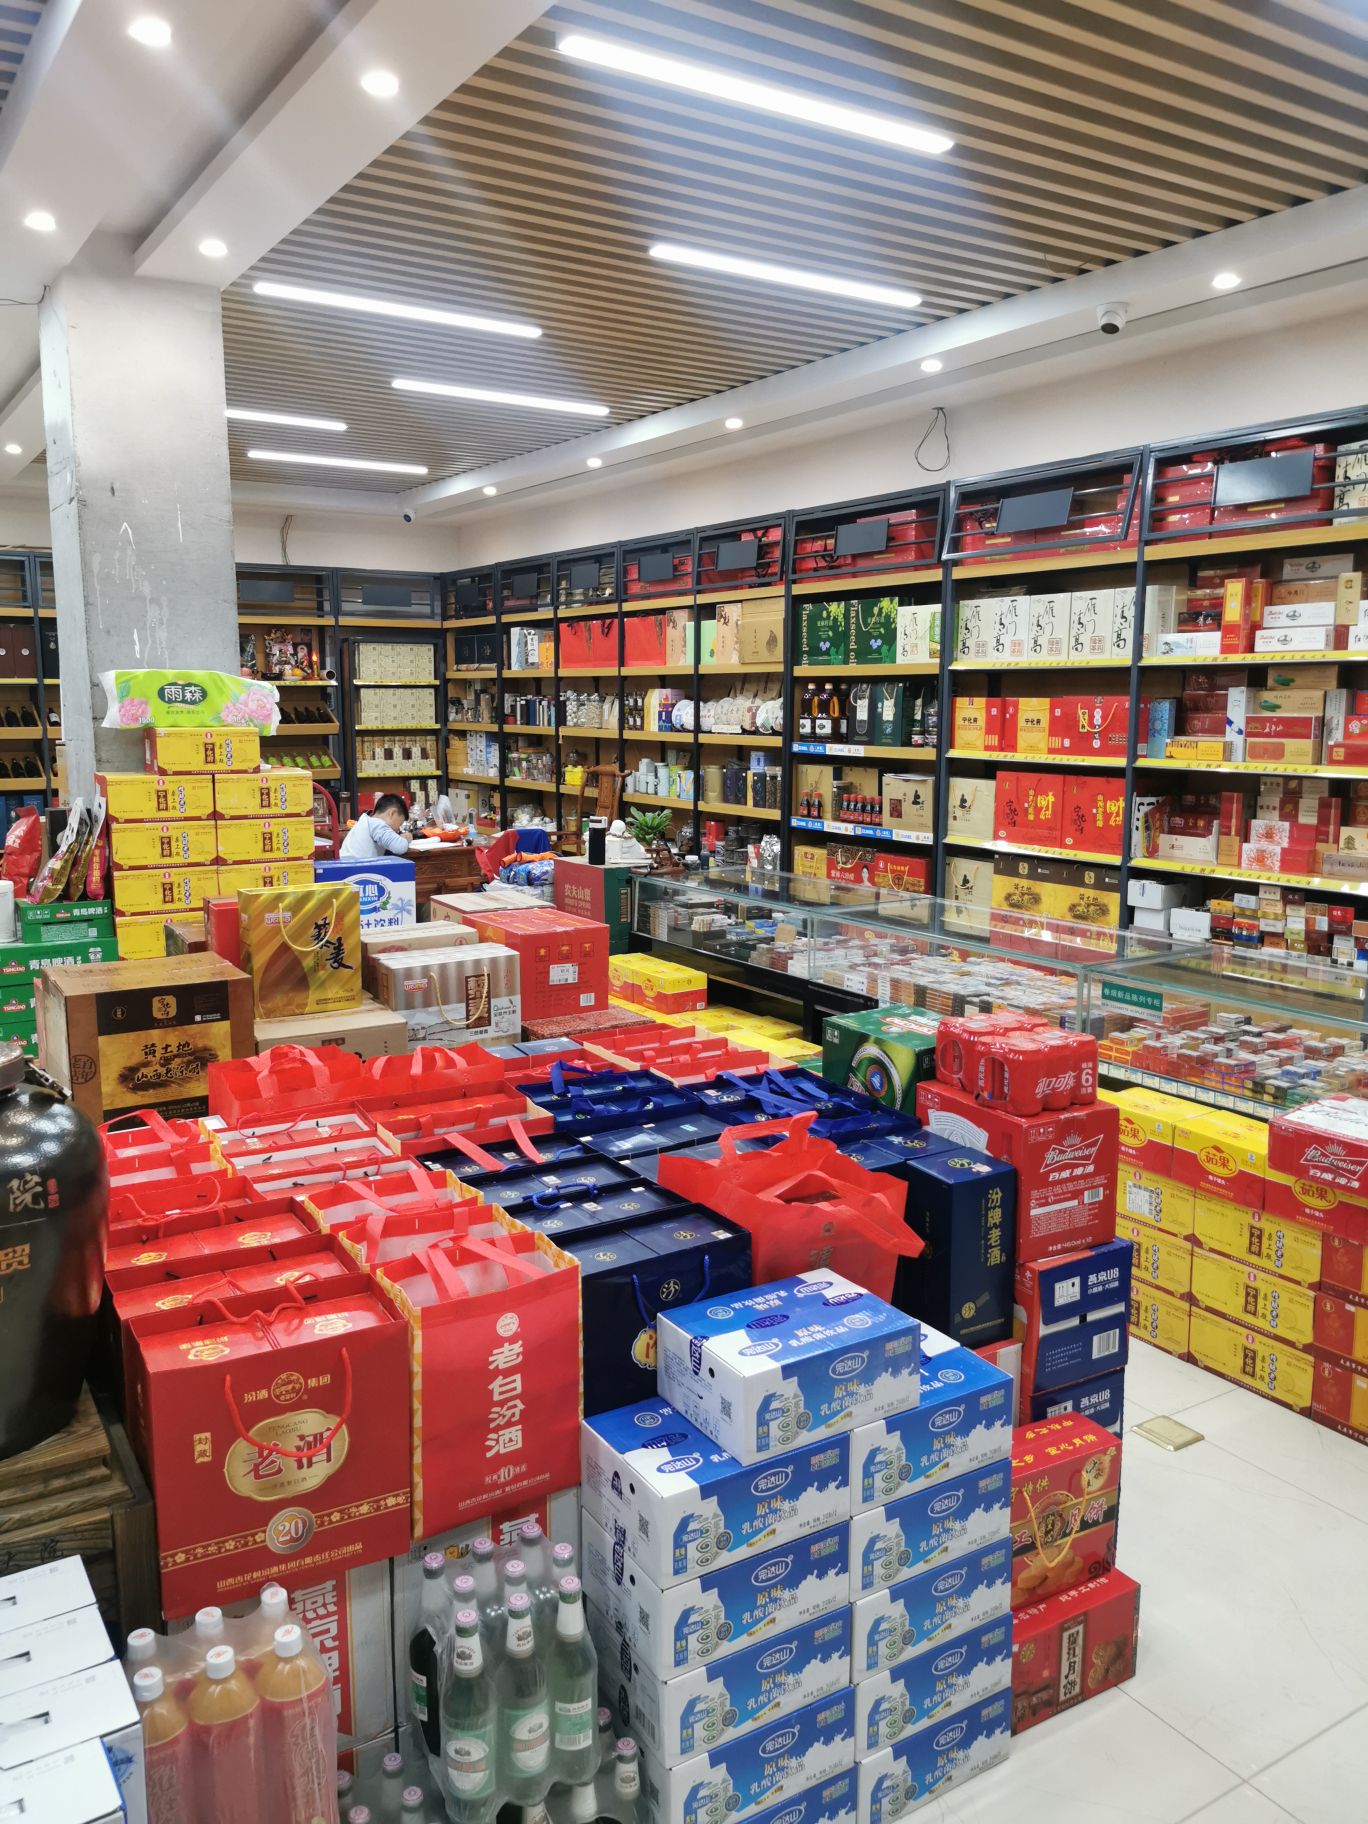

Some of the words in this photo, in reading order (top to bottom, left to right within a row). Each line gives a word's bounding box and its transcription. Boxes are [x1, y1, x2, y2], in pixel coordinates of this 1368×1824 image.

[801, 603, 813, 654] Flaxseed
[849, 600, 859, 651] Flaxseed
[165, 685, 202, 702] 雨森
[141, 1042, 193, 1060] 黄土地
[1035, 1071, 1078, 1097] 可口可乐
[1081, 1069, 1093, 1087] 6
[1045, 1147, 1097, 1164] Budweiser
[1305, 1149, 1363, 1172] Budweiser
[987, 1187, 1002, 1267] 汾牌老酒
[1087, 1267, 1119, 1285] 燕京U8
[742, 1340, 776, 1355] 完达山
[835, 1357, 862, 1375] 完达山
[308, 1374, 331, 1388] 集团
[485, 1340, 525, 1458] 老白汾酒
[1080, 1389, 1110, 1408] 燕京U8
[934, 1411, 959, 1428] 完达山
[243, 1427, 334, 1481] 老酒
[660, 1457, 695, 1473] 完达山
[757, 1473, 786, 1490] 完达山
[756, 1495, 783, 1515] 原味
[934, 1496, 957, 1513] 完达山
[278, 1518, 303, 1541] 20
[758, 1563, 786, 1582] 完达山
[938, 1574, 961, 1591] 完达山
[756, 1584, 783, 1606] 原味
[763, 1649, 790, 1668] 完达山
[938, 1654, 961, 1671] 完达山
[761, 1670, 788, 1690] 原味
[765, 1732, 793, 1752] 完达山
[938, 1728, 961, 1745] 完达山
[764, 1753, 790, 1775] 原味
